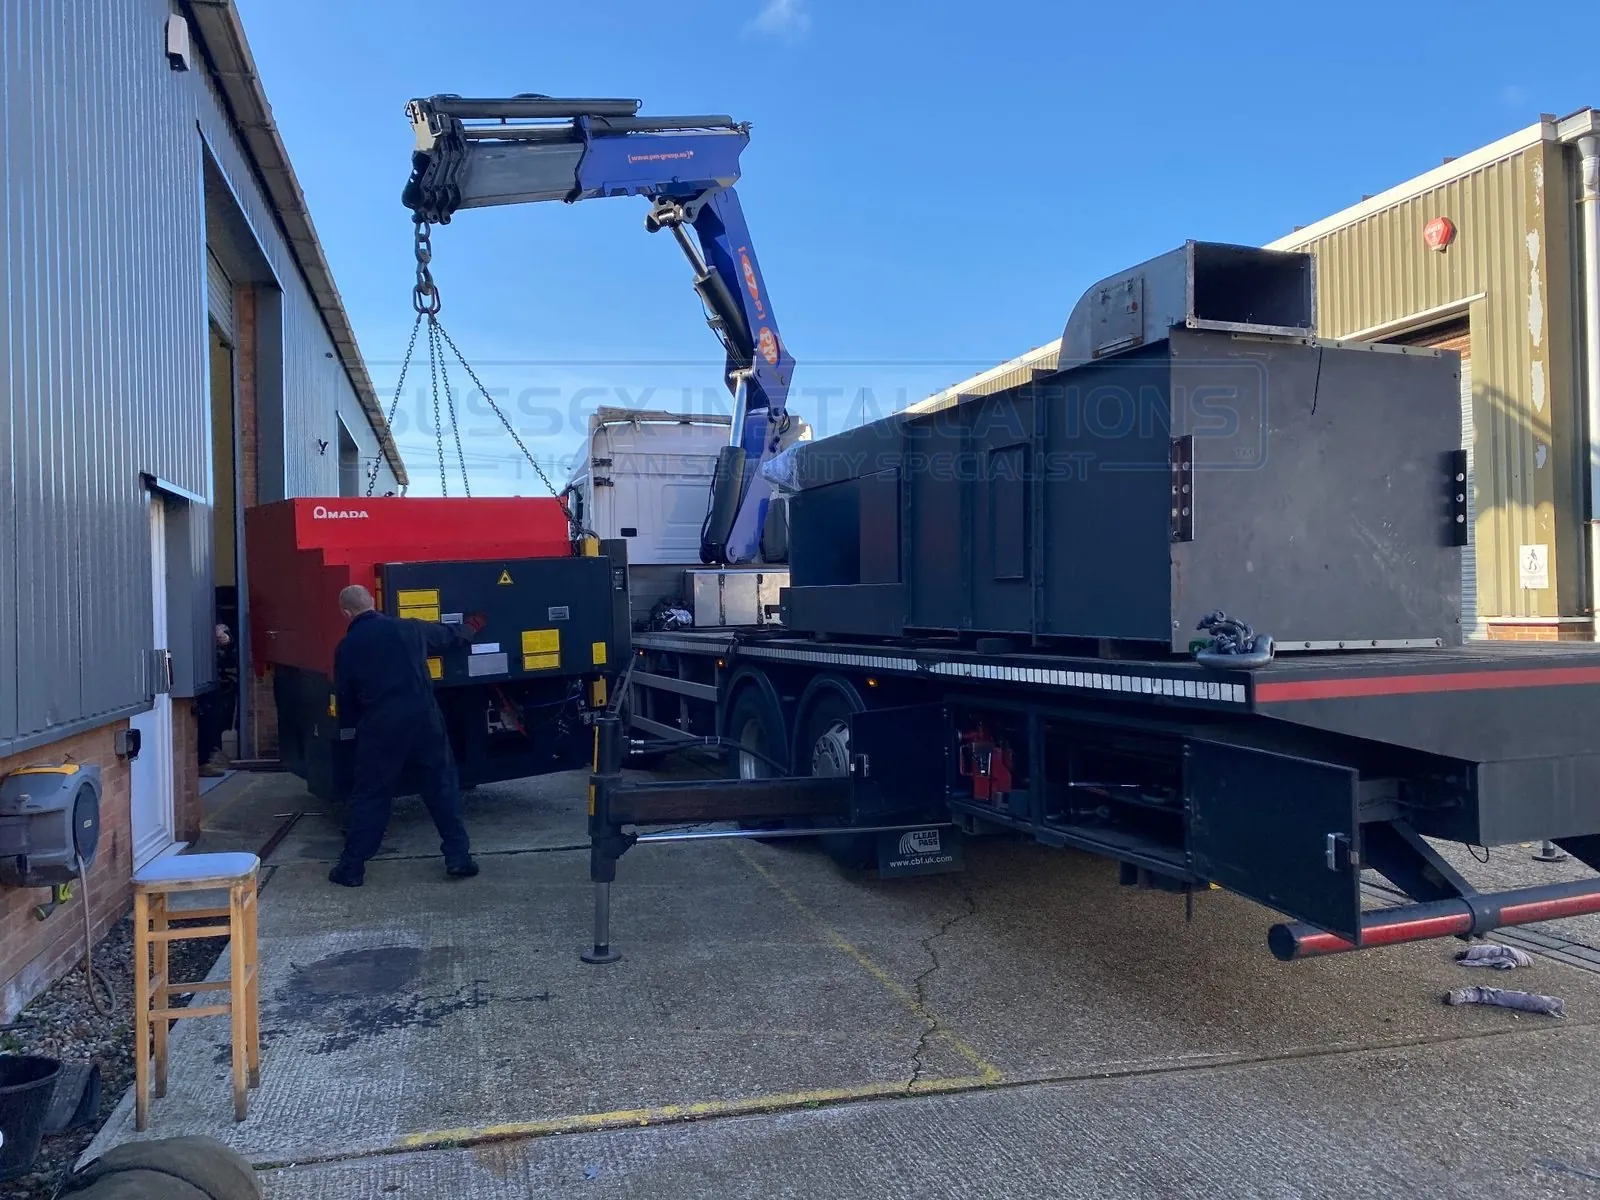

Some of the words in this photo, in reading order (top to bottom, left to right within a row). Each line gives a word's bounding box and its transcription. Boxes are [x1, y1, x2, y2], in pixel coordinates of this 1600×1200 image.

[912, 831, 938, 839] CLEAR
[918, 839, 938, 847] PASS
[889, 856, 953, 867] www.cbf.uk.com
